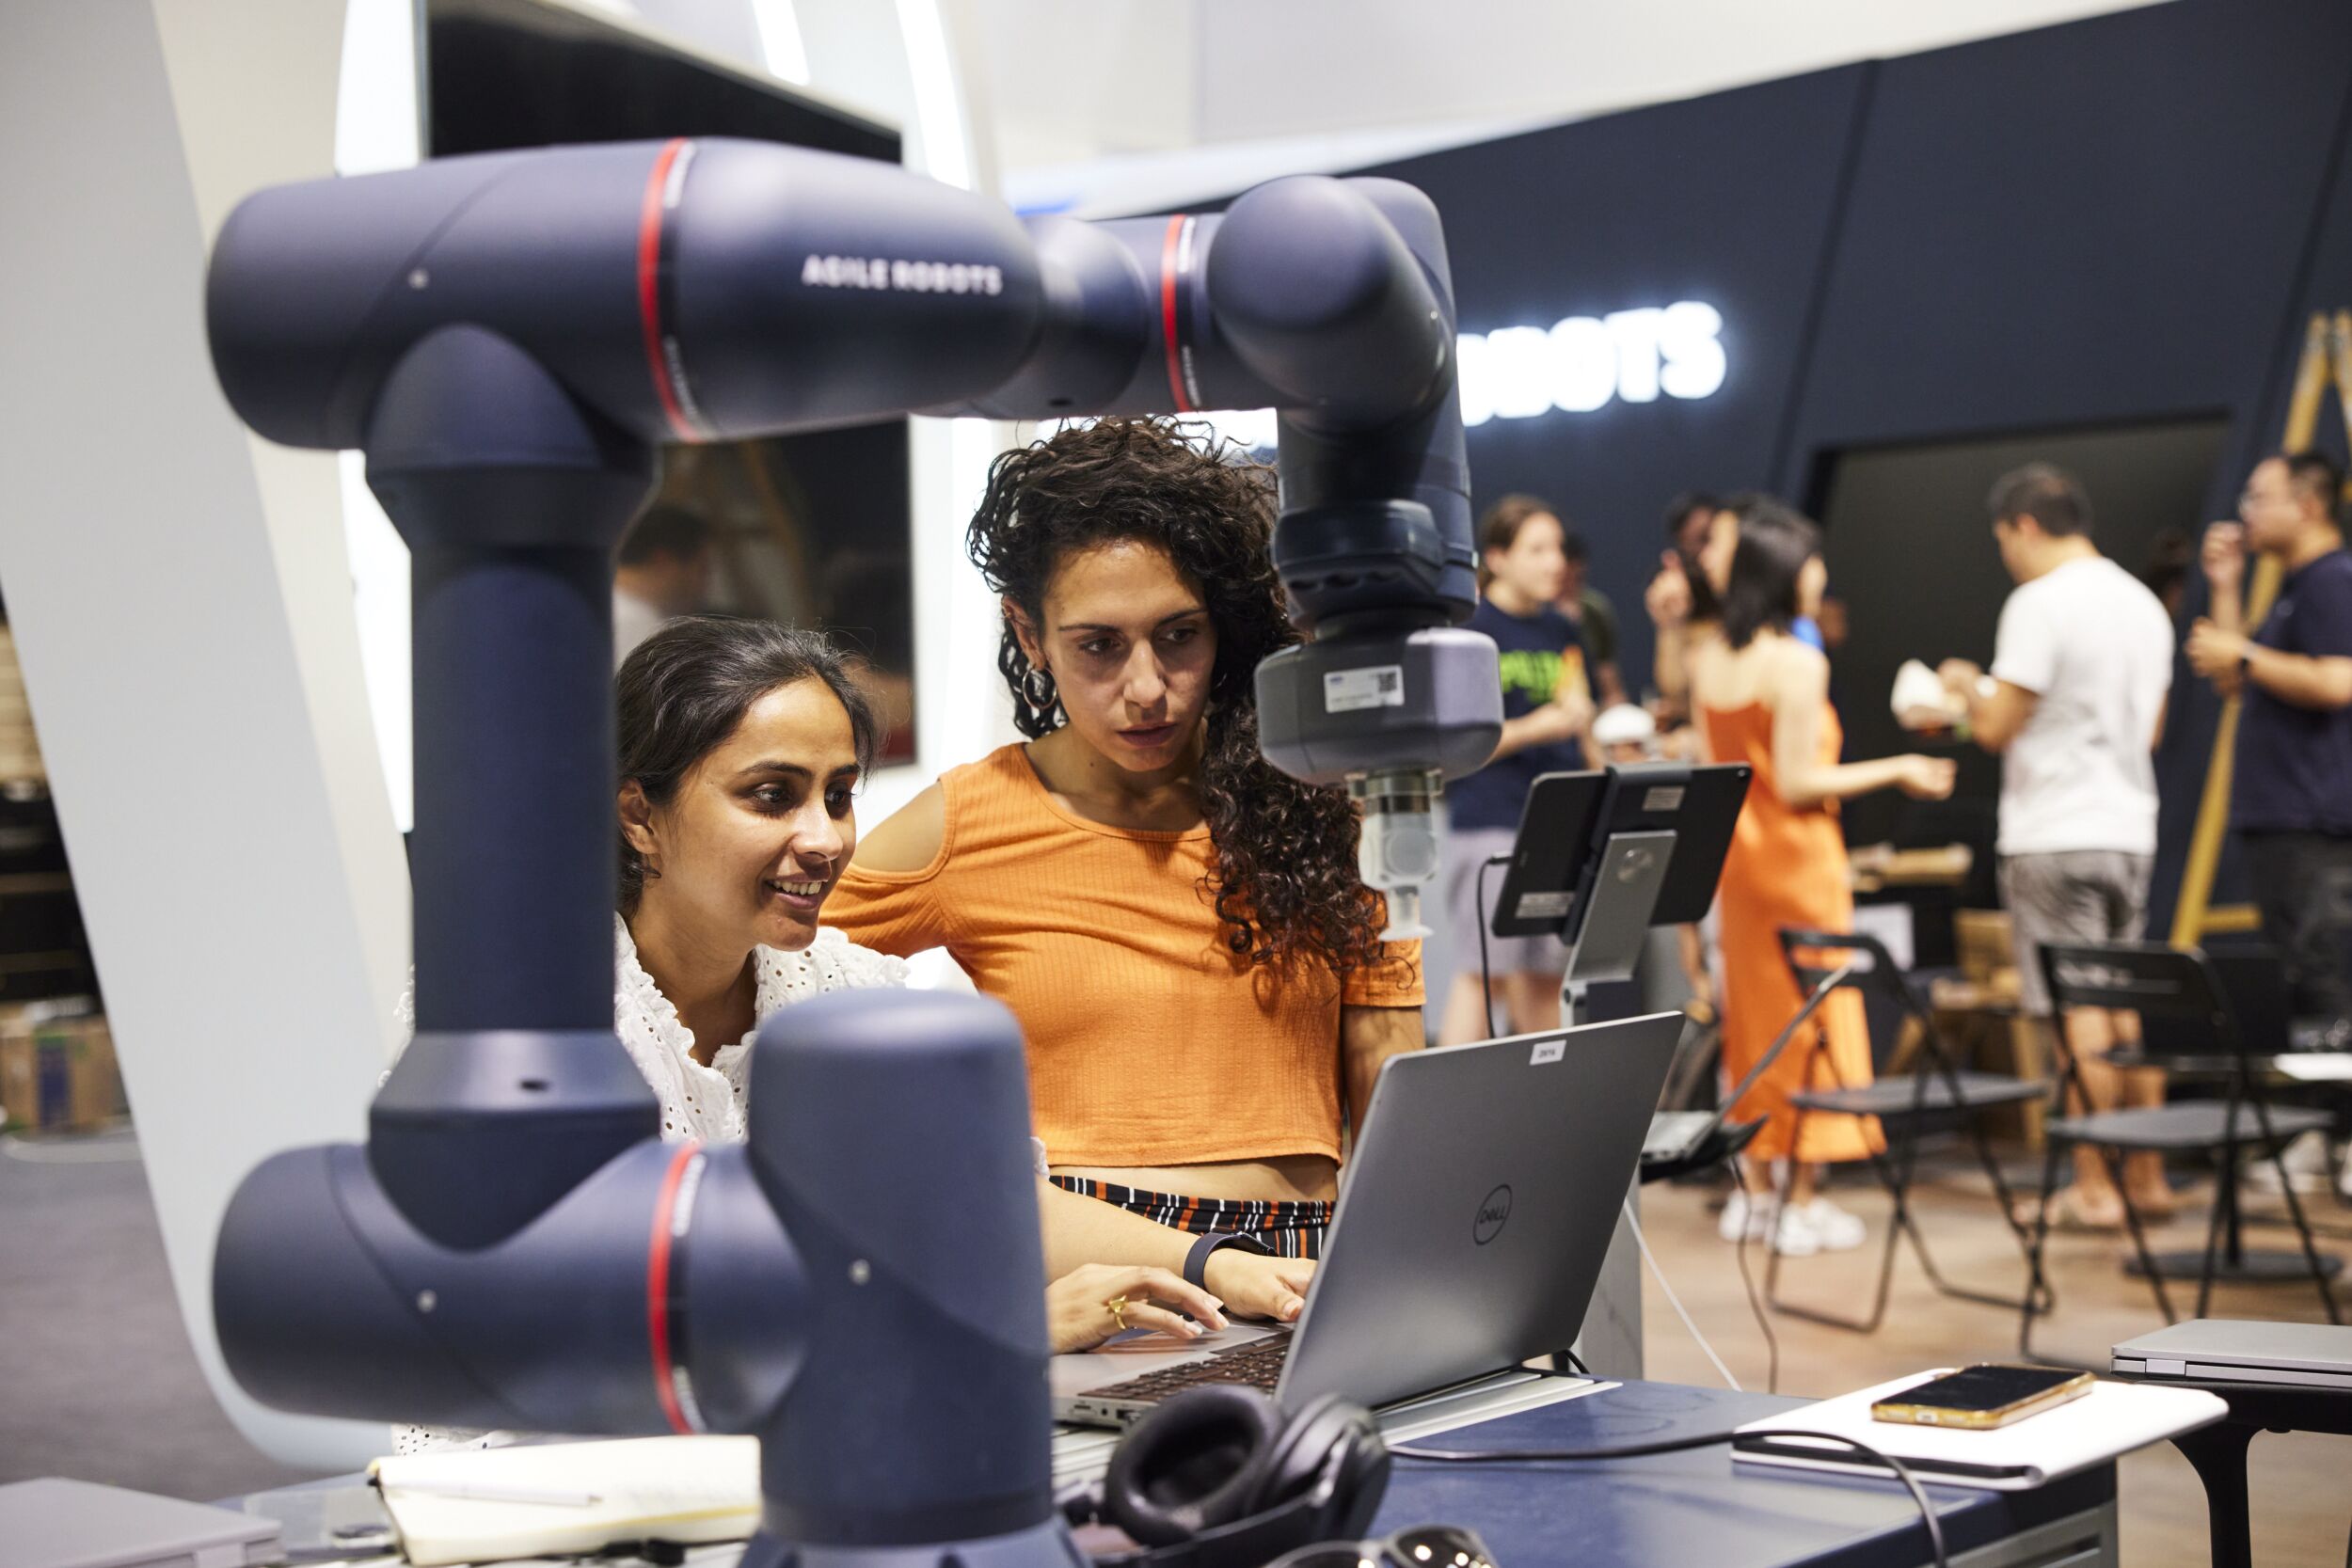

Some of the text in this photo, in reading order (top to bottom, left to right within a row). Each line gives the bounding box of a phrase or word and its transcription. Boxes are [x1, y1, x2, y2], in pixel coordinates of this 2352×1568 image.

[802, 254, 1003, 295] AGILE ROBOTS
[1479, 1206, 1505, 1224] DELL
